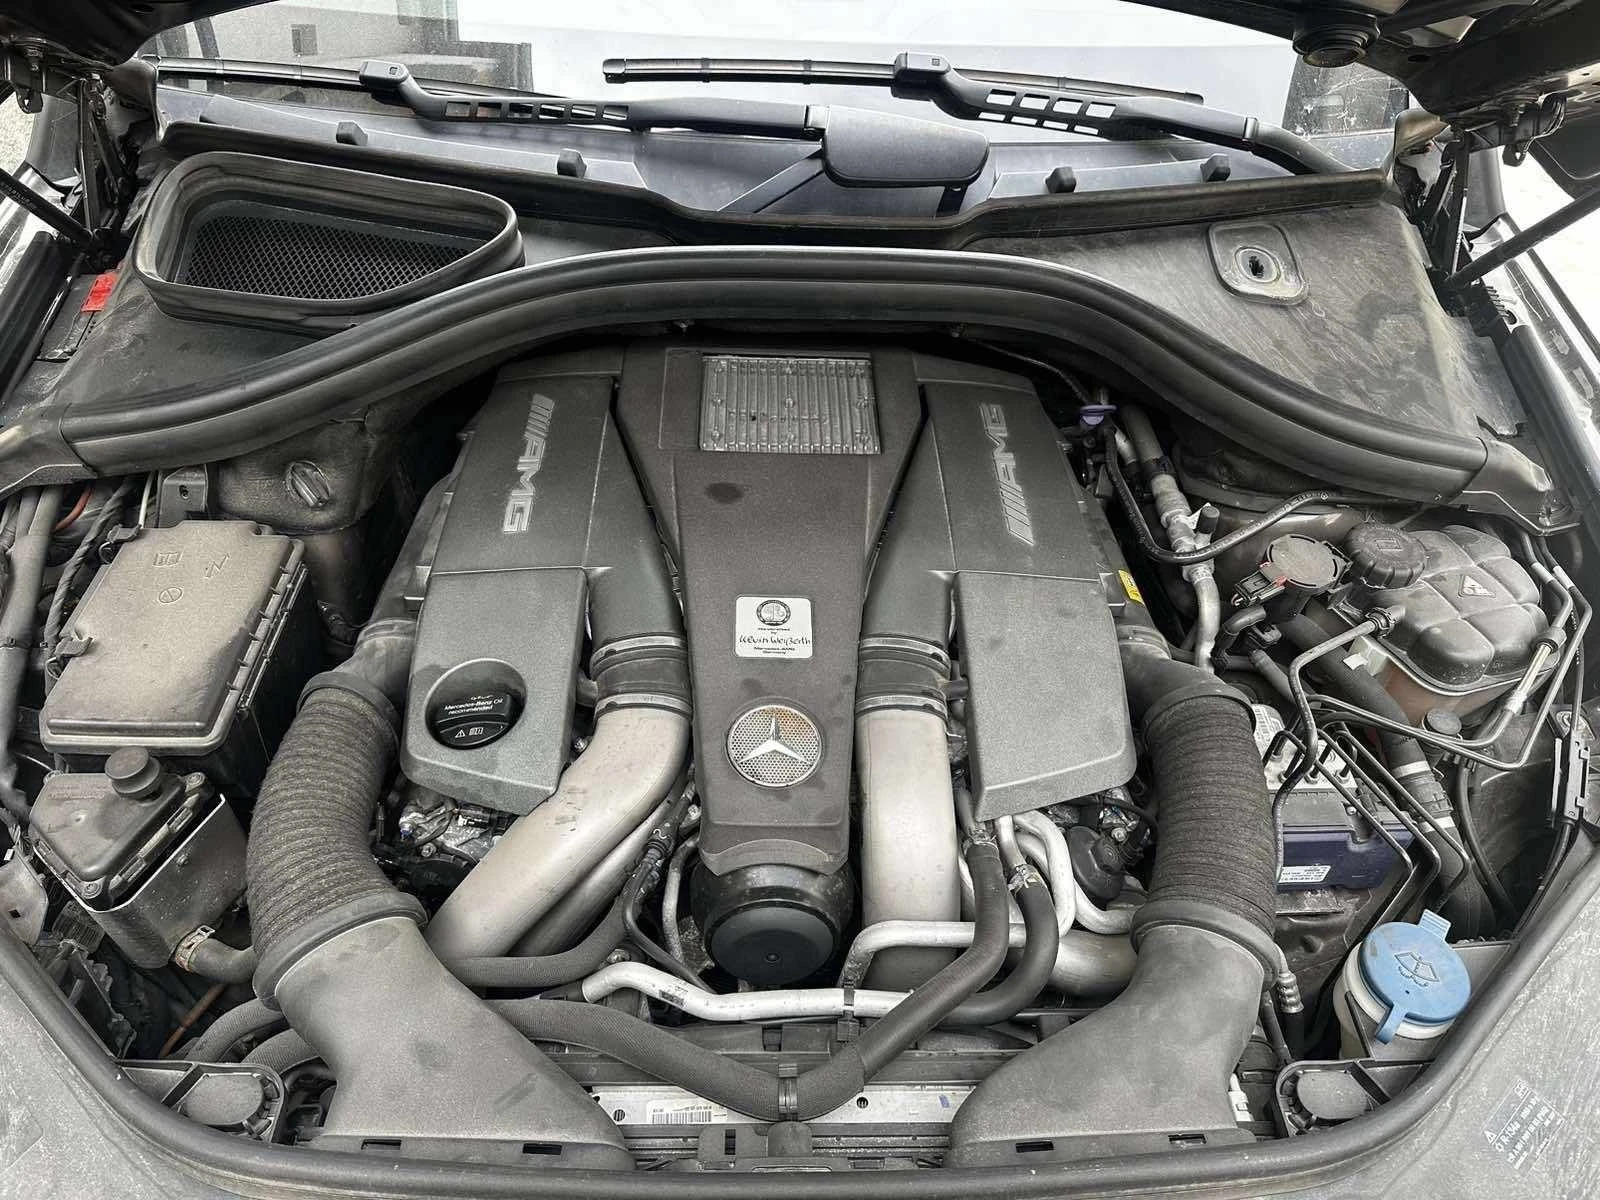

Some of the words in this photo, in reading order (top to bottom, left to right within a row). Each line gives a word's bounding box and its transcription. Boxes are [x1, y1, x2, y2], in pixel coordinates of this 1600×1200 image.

[979, 402, 1024, 498] AMG
[503, 430, 548, 534] AMG
[444, 699, 493, 711] Mercedes-Benz
[447, 705, 493, 715] recommended
